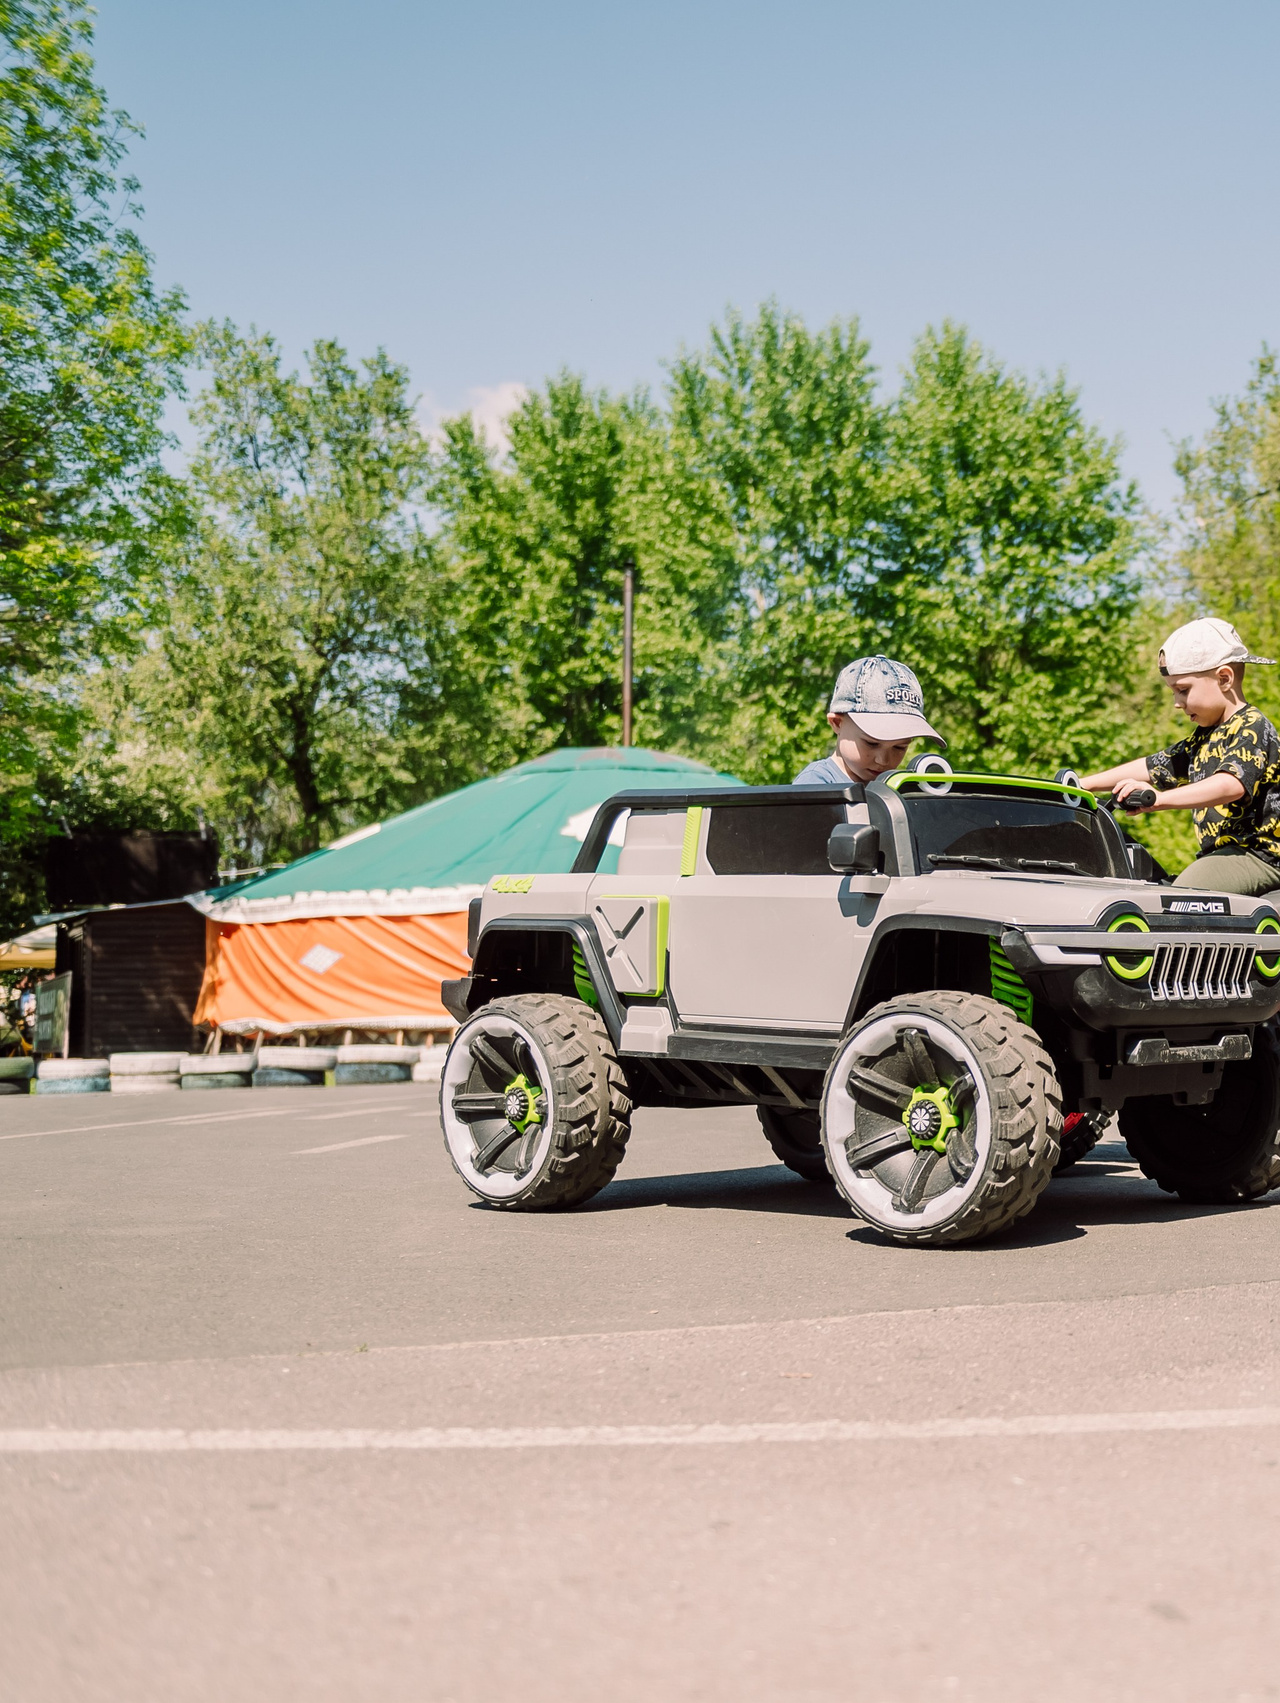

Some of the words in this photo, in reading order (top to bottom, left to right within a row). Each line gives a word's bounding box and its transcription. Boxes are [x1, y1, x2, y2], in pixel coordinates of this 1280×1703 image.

[886, 688, 920, 704] SPORT
[491, 875, 536, 893] 4x4
[1187, 902, 1225, 913] AMG
